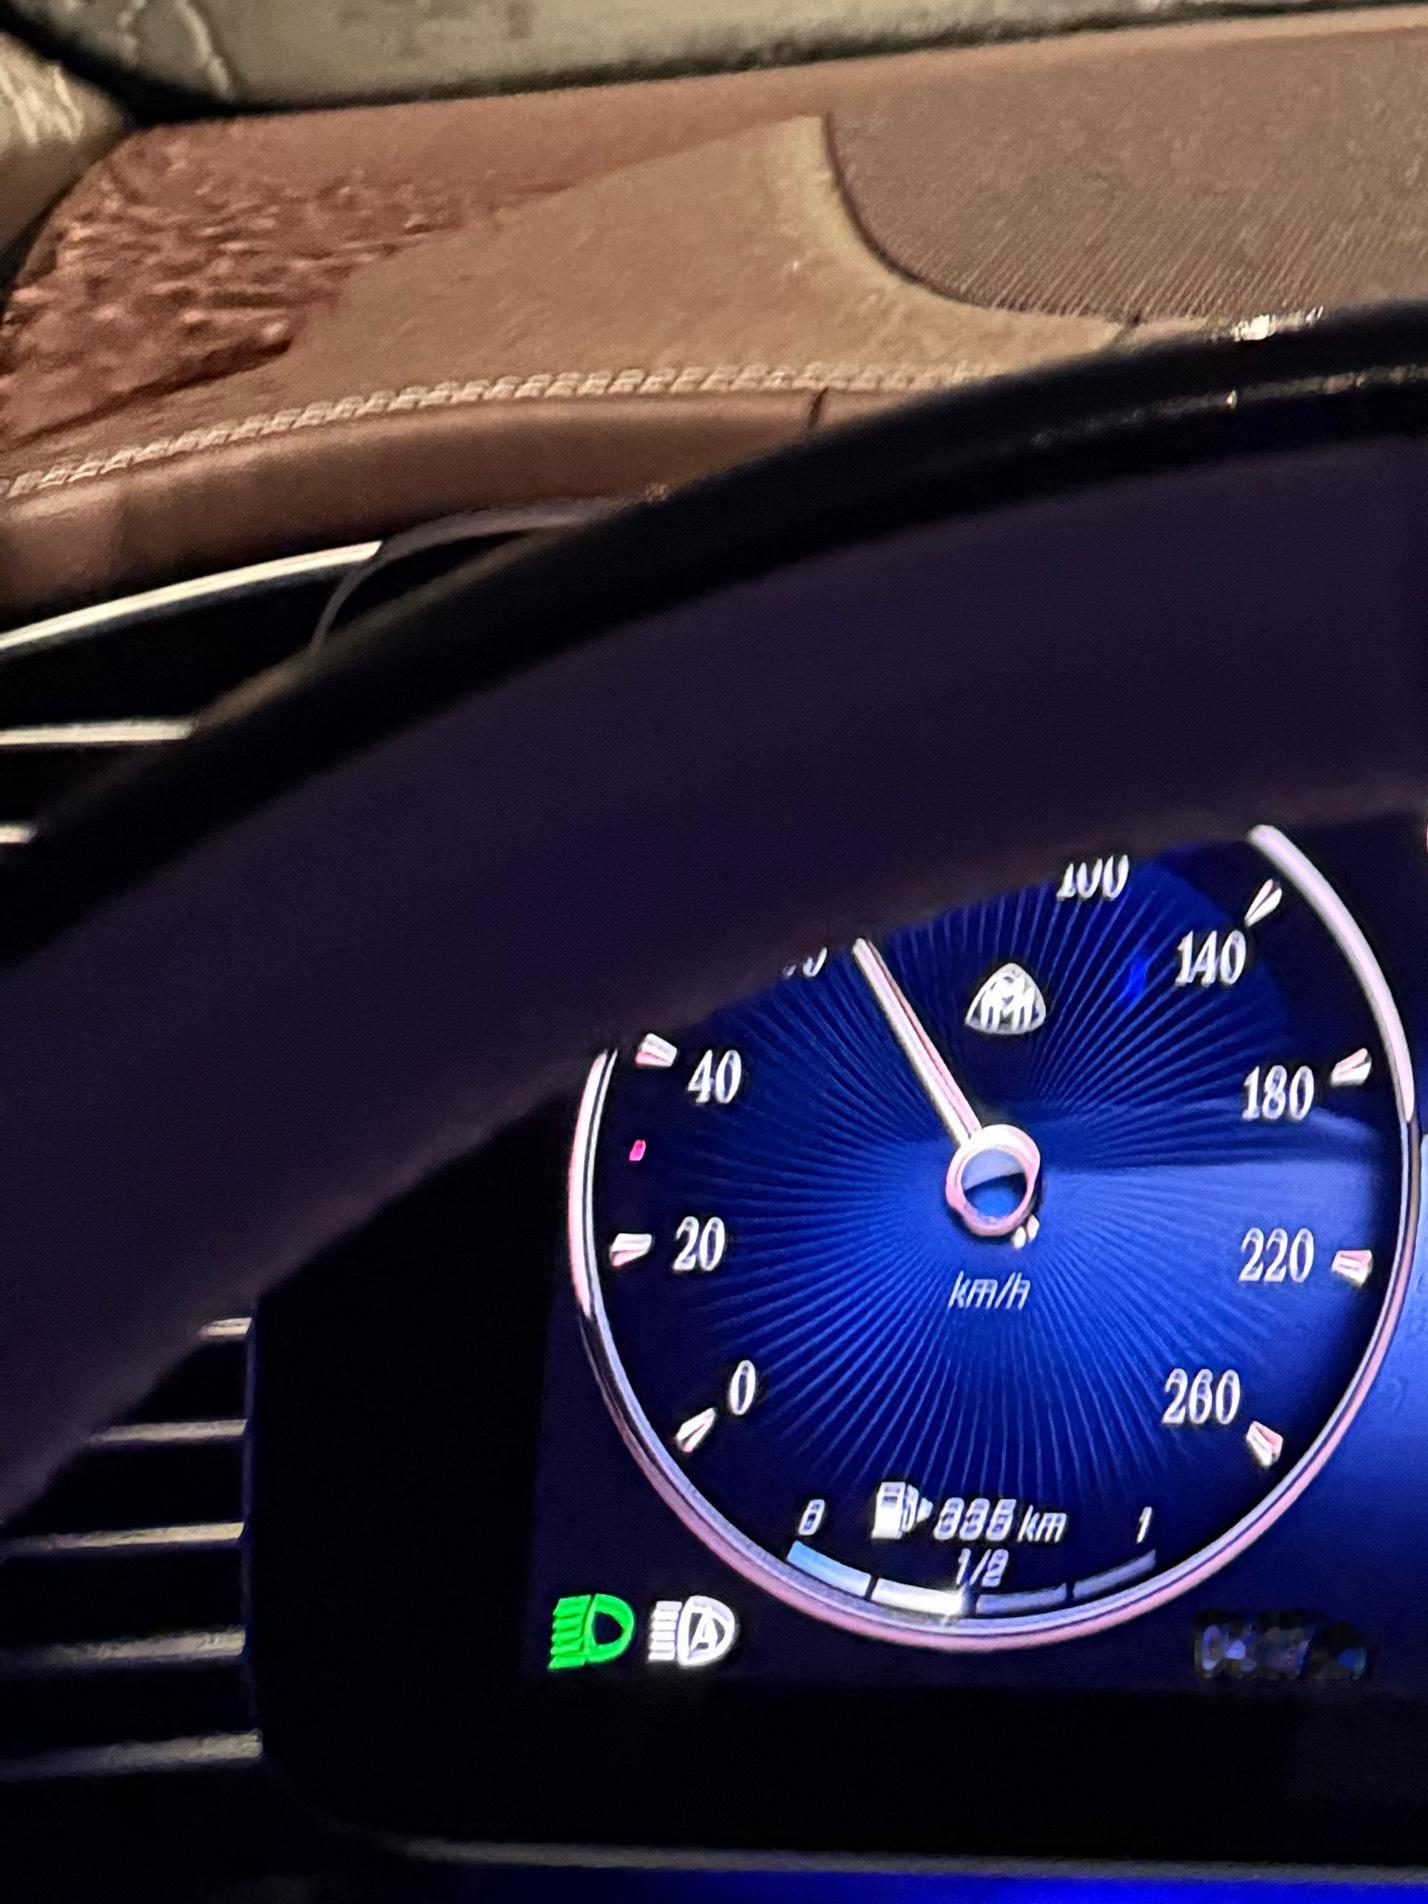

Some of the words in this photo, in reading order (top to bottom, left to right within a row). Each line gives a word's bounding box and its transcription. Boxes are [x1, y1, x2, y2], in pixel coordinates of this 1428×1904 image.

[1175, 929, 1247, 987] 140
[687, 1048, 743, 1106] 40
[1242, 1064, 1314, 1121] 180
[673, 1215, 726, 1271] 20
[1239, 1229, 1314, 1285] 220
[948, 1271, 1032, 1309] km/h
[728, 1360, 757, 1416] 0
[1161, 1367, 1241, 1425] 260
[1017, 1505, 1067, 1543] km
[1136, 1506, 1152, 1544] 1
[956, 1548, 1008, 1587] 1/2
